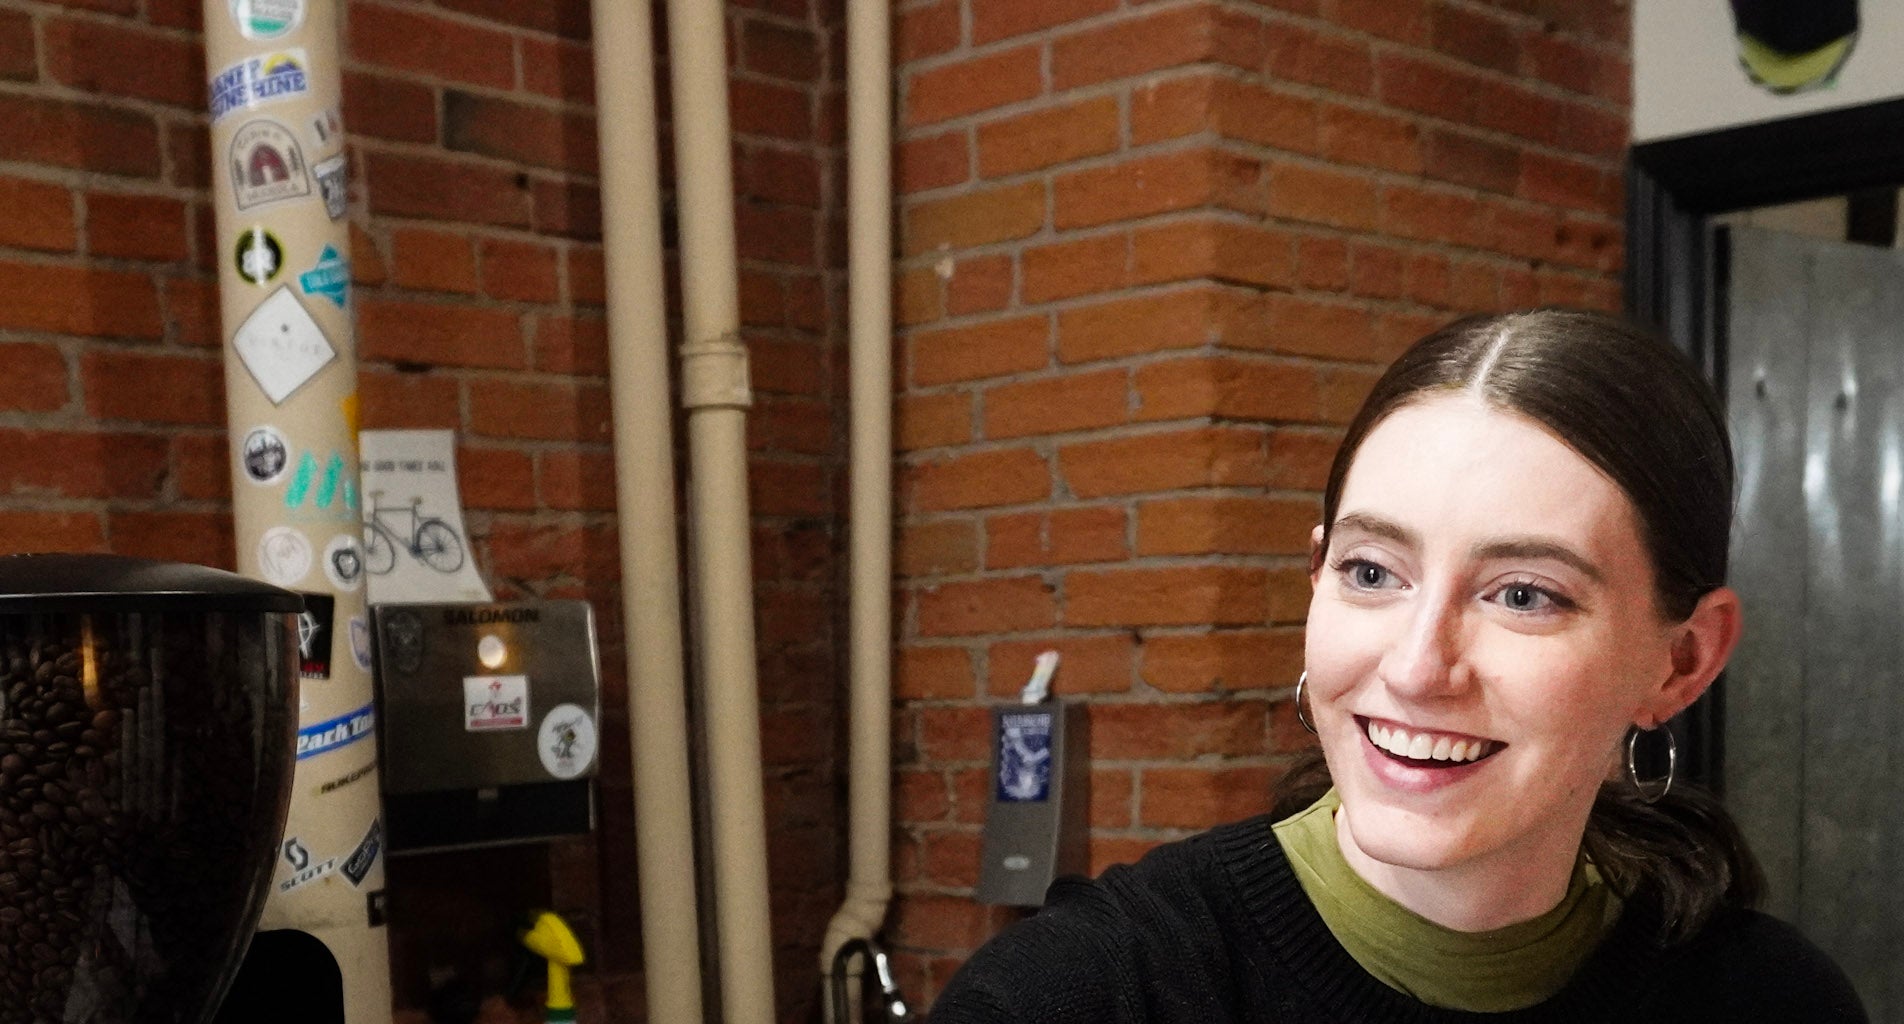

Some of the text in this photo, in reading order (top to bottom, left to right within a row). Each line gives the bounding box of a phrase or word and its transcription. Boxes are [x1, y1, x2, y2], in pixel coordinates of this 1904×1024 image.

[442, 608, 539, 624] SALOMON
[297, 723, 349, 754] Park
[280, 859, 335, 892] SCOTT
